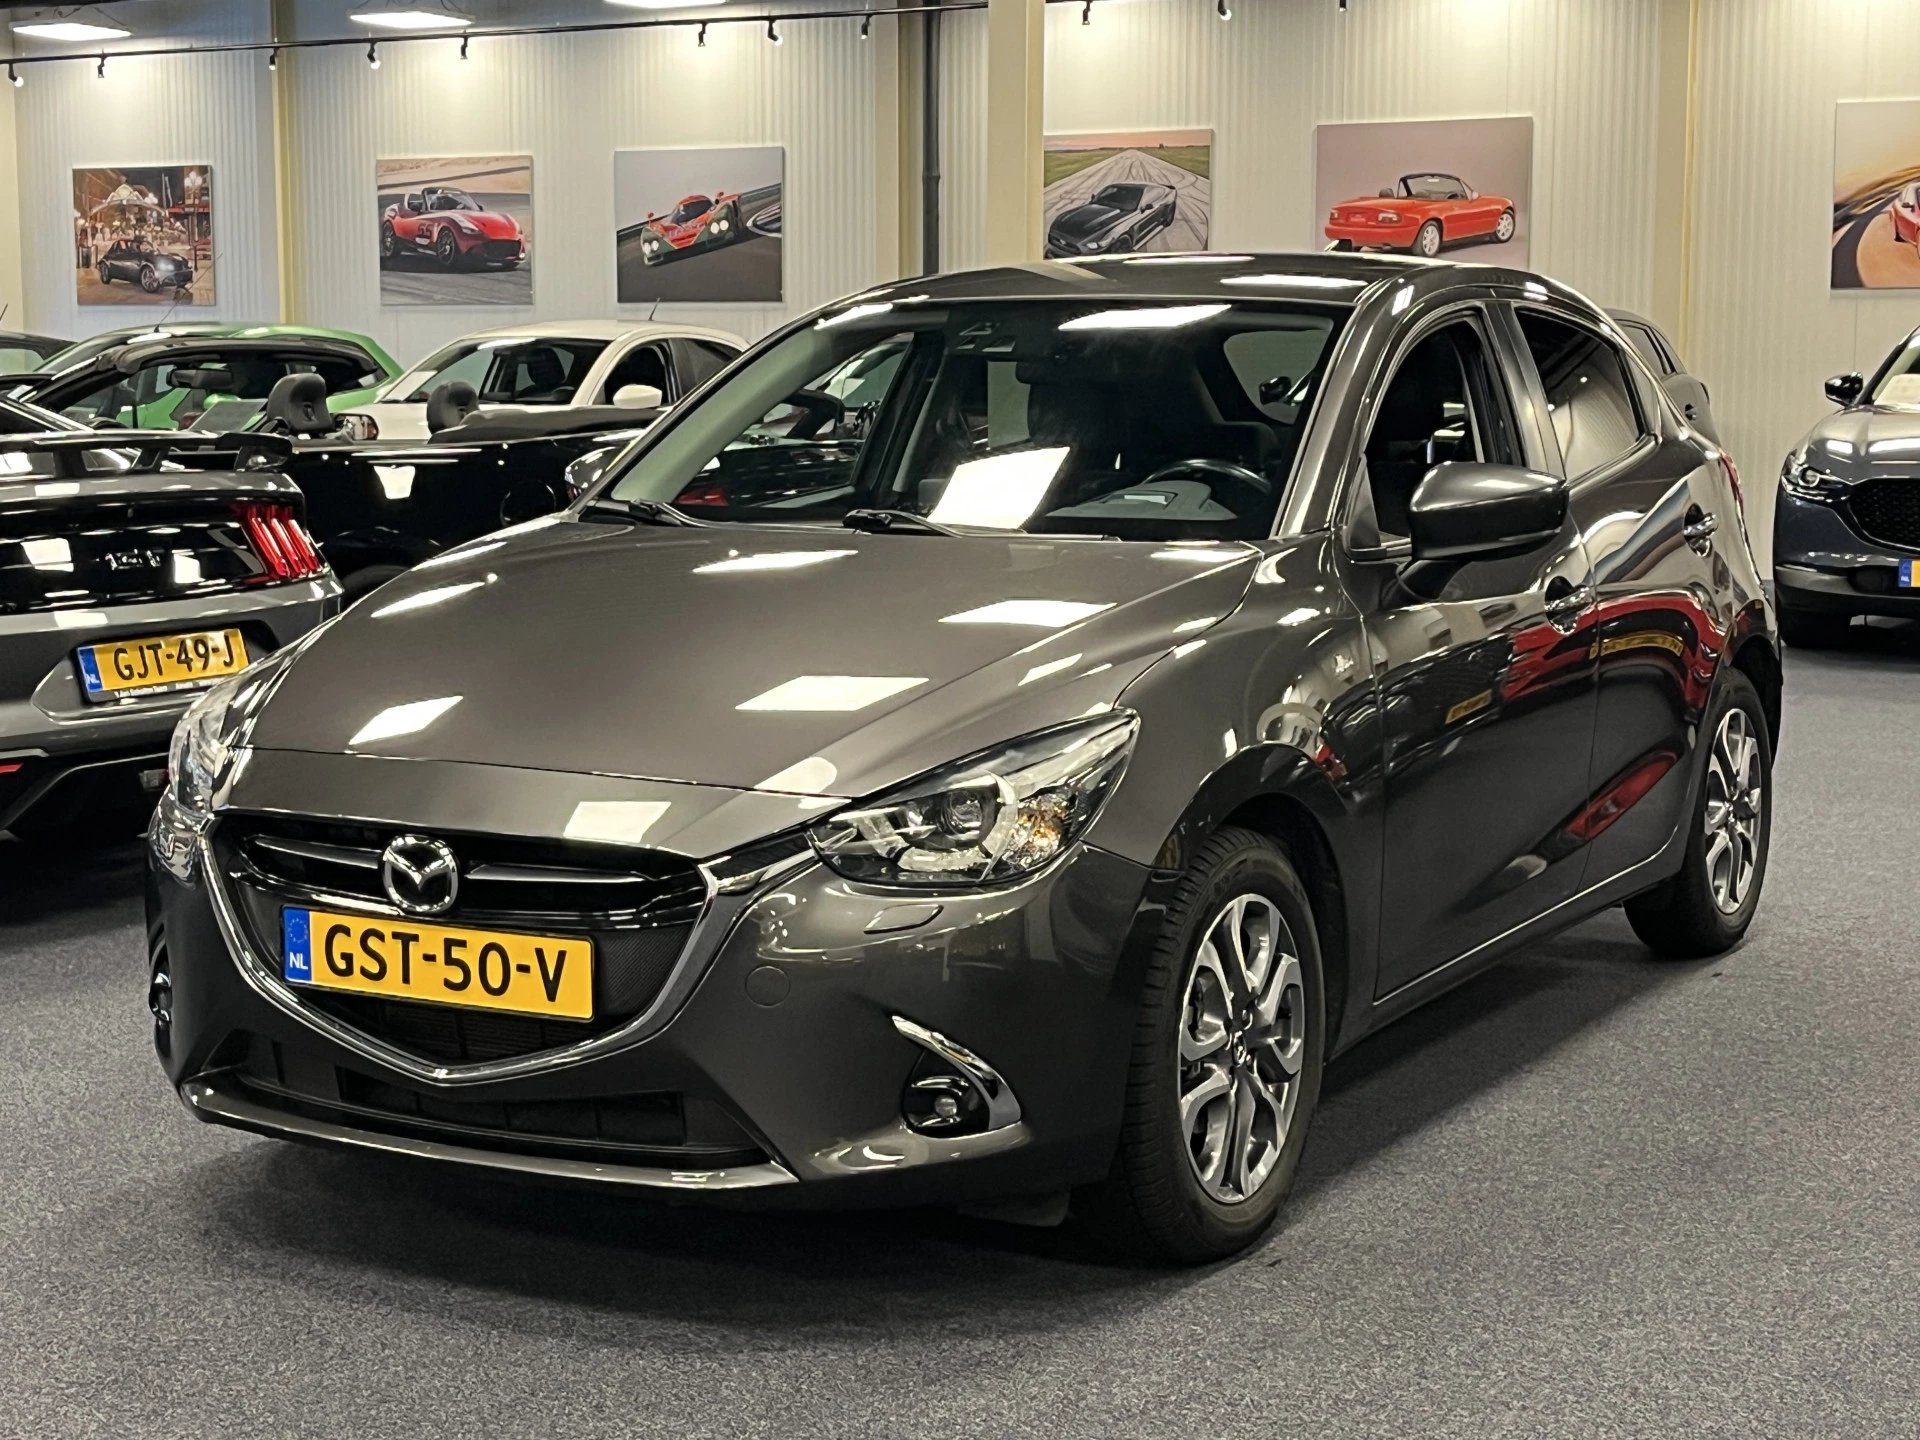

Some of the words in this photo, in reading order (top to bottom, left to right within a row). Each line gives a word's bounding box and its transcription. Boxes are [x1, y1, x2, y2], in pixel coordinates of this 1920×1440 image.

[113, 634, 235, 681] GJT-49-J
[86, 674, 100, 685] NL
[289, 951, 309, 970] NL
[324, 923, 568, 1003] GST-50-V
